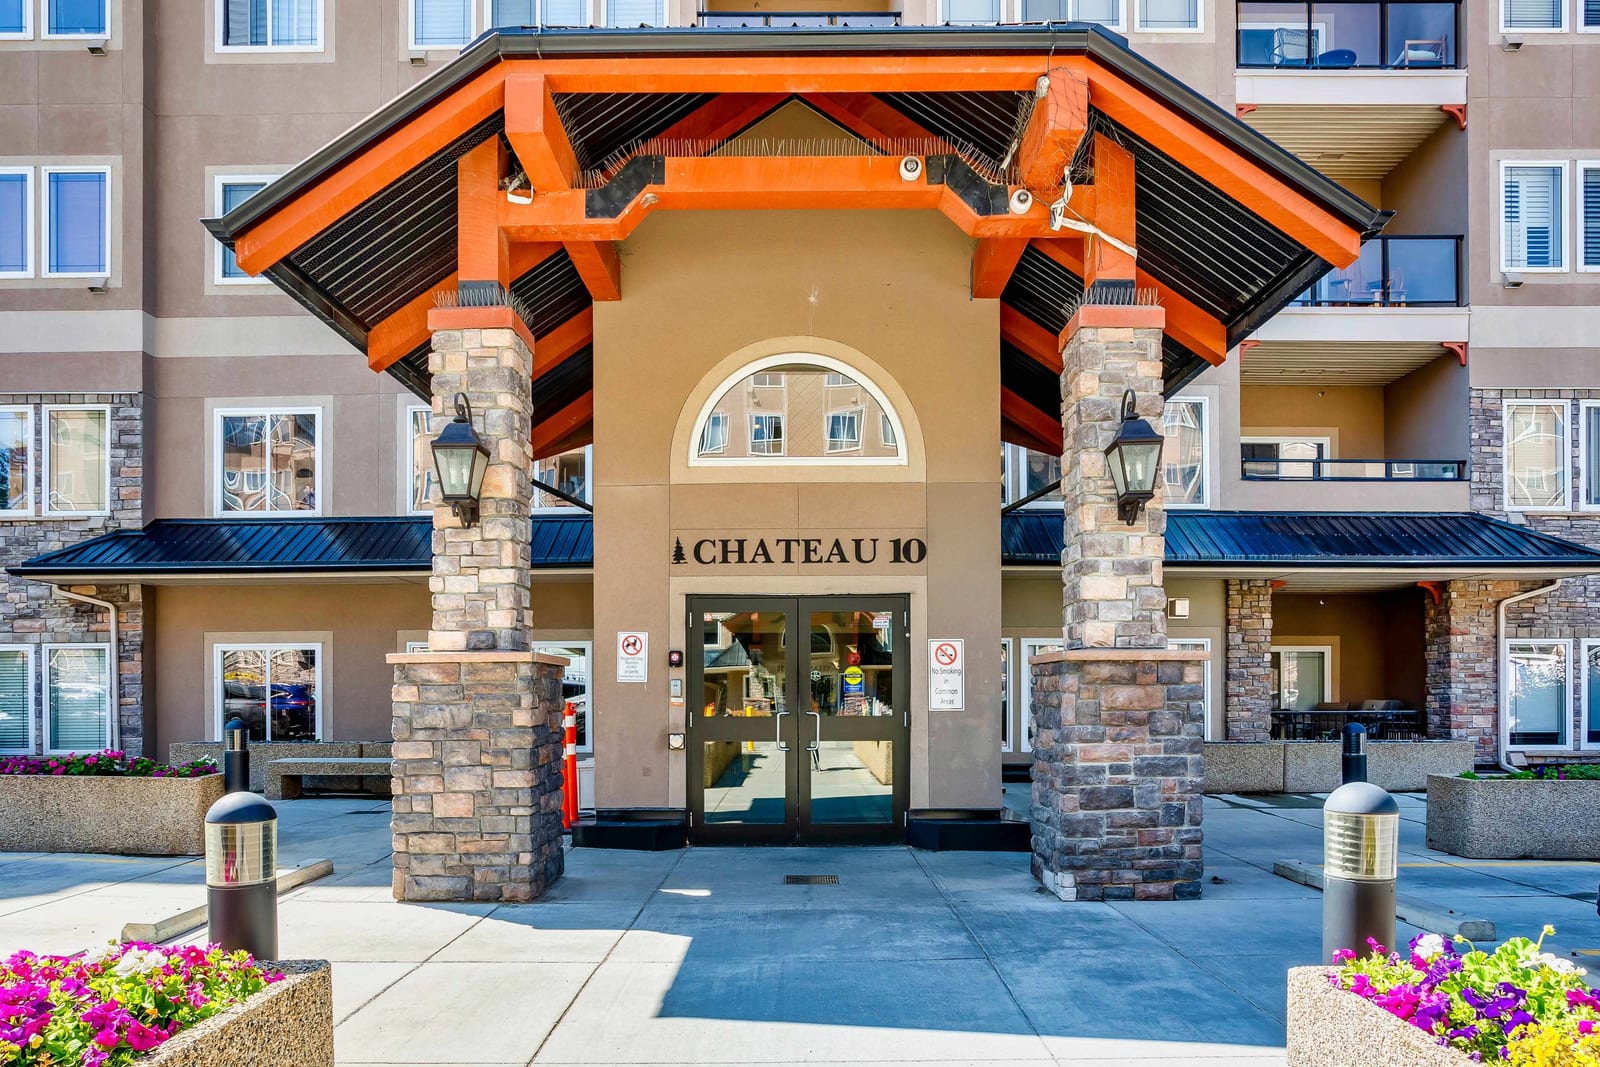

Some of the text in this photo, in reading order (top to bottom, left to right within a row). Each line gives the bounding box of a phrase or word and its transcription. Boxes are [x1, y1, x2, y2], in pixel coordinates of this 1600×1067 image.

[693, 538, 927, 565] CHATEAU 10
[931, 667, 962, 676] No Smoking
